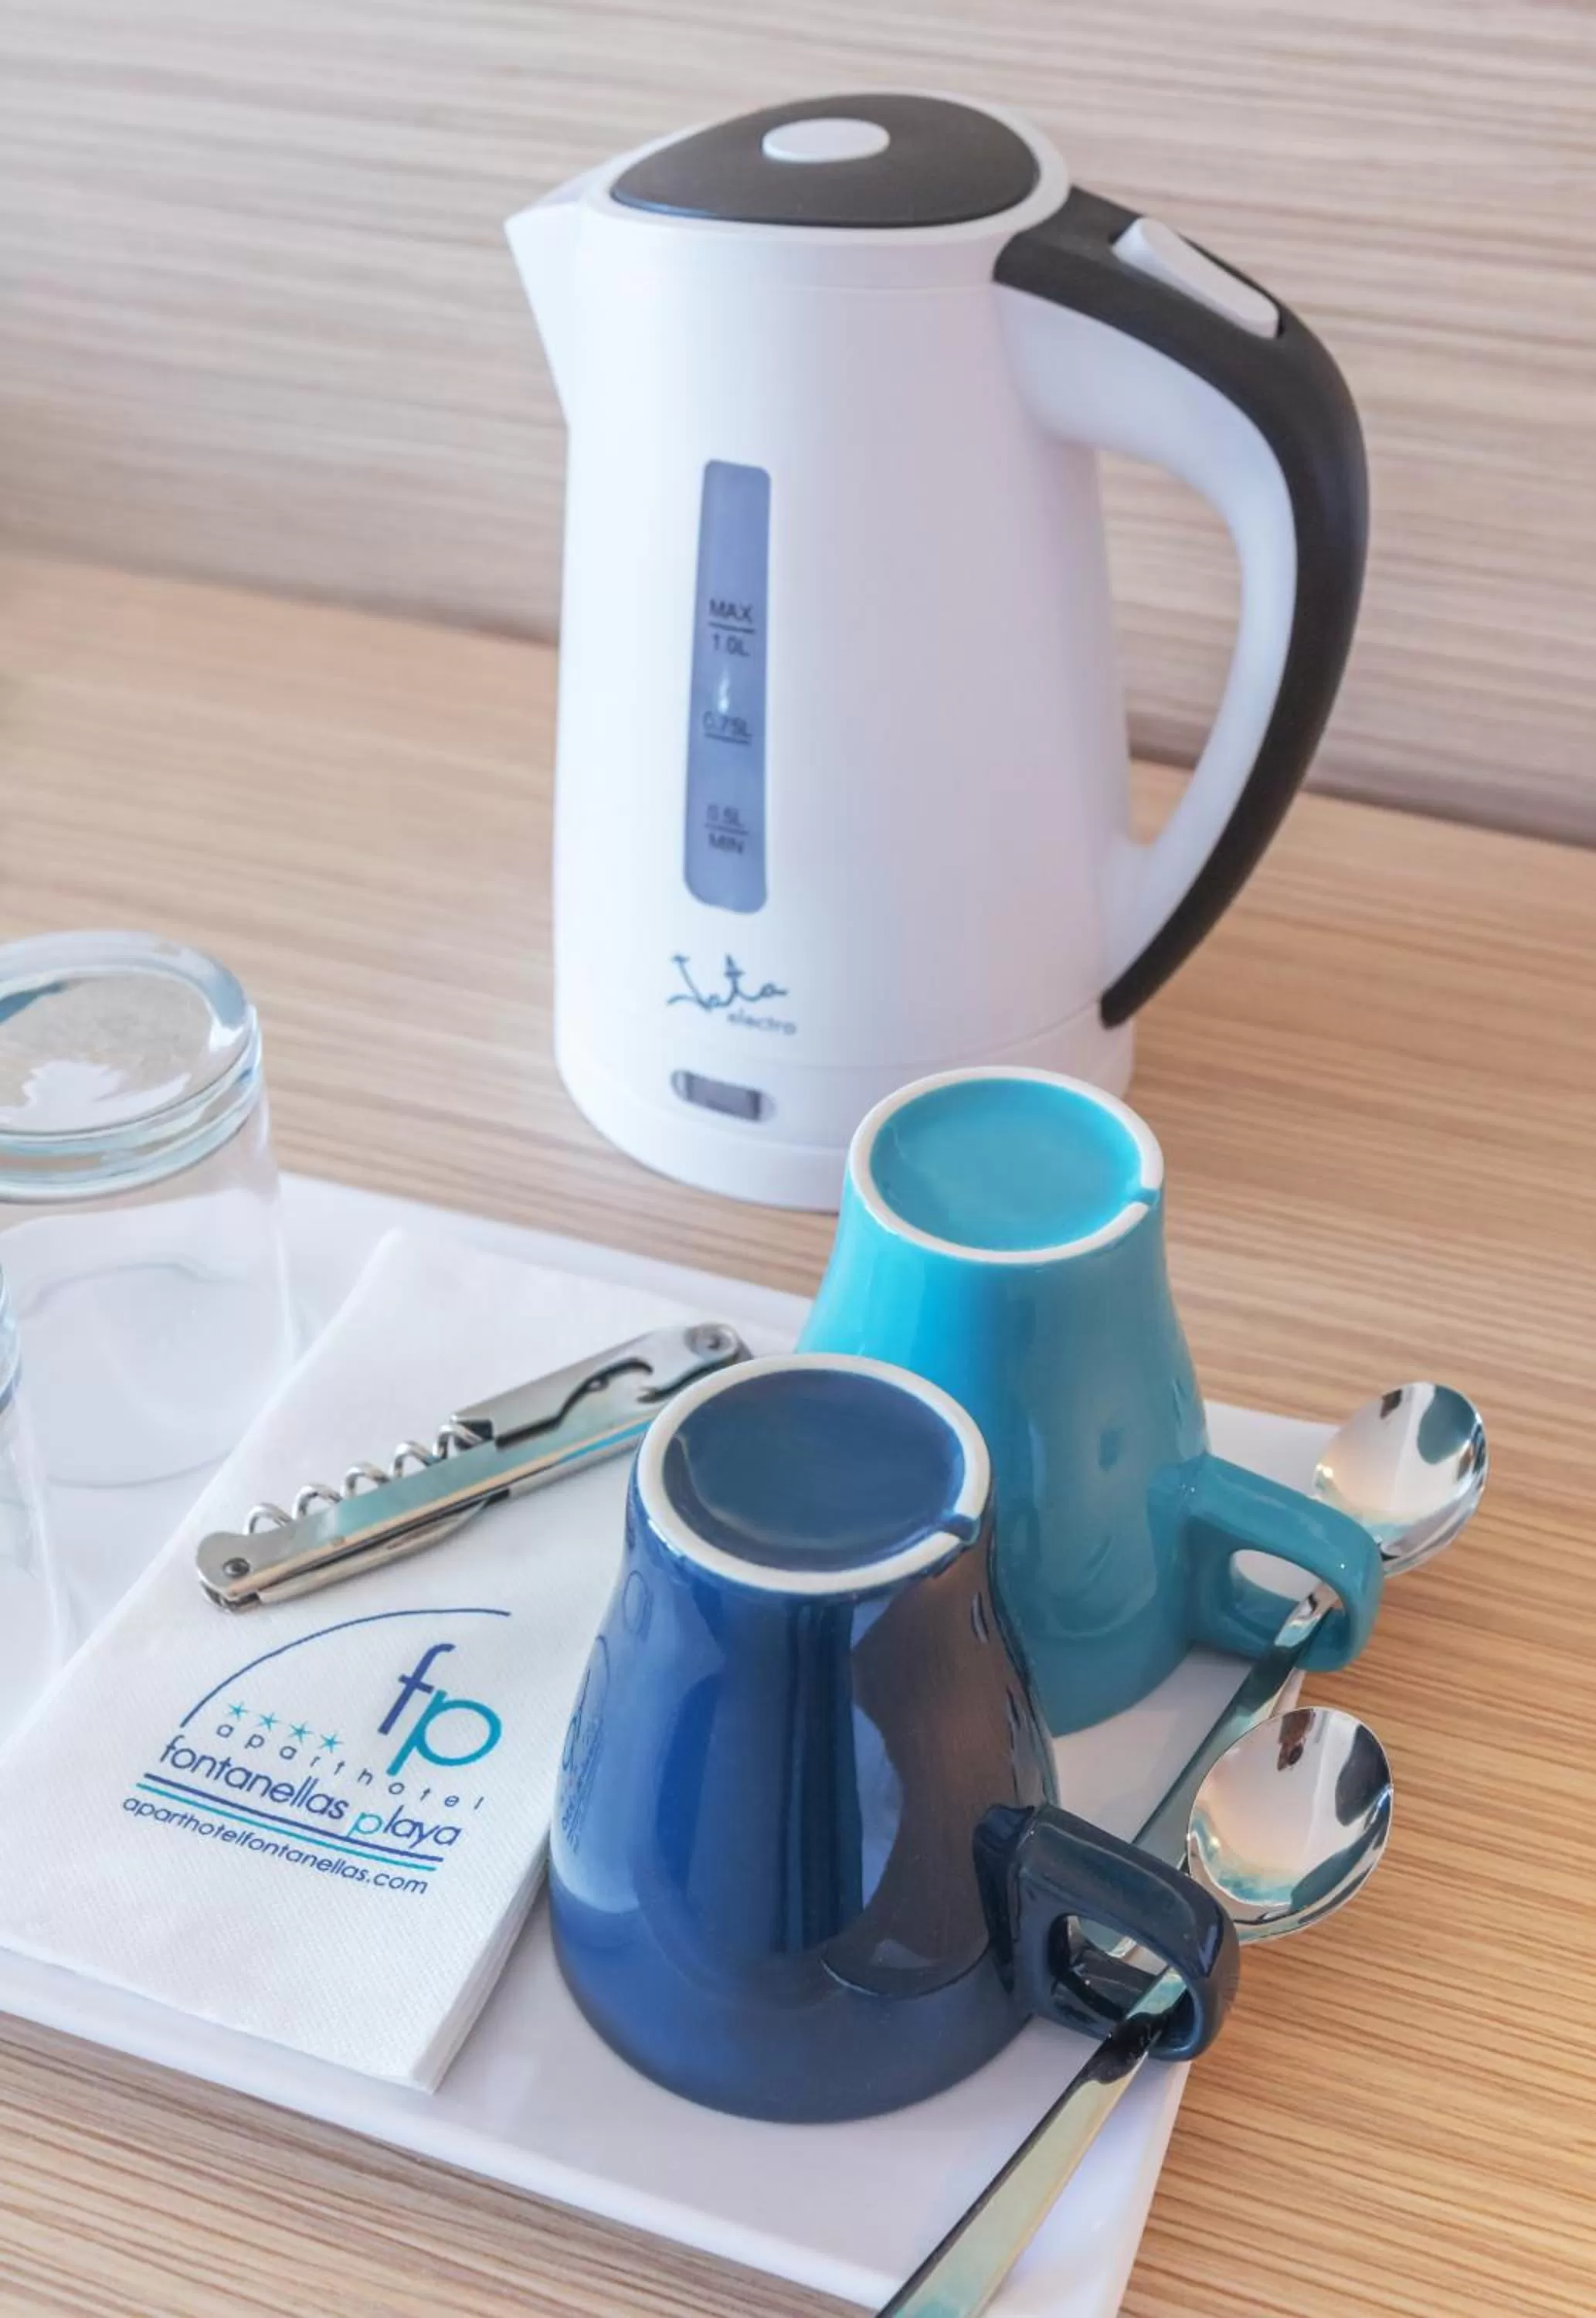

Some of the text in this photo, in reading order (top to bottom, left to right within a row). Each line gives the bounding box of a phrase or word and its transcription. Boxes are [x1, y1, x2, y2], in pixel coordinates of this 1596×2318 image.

[708, 598, 753, 624] MAX
[711, 633, 750, 657] 10L
[702, 710, 752, 737] 075L
[706, 804, 744, 827] 05L
[708, 834, 745, 856] MIN
[378, 1643, 503, 1776] fp
[216, 1722, 484, 1811] aparthotel
[159, 1734, 462, 1849] fontanellas playa
[122, 1796, 430, 1895] aparthotelfontanellas.com
